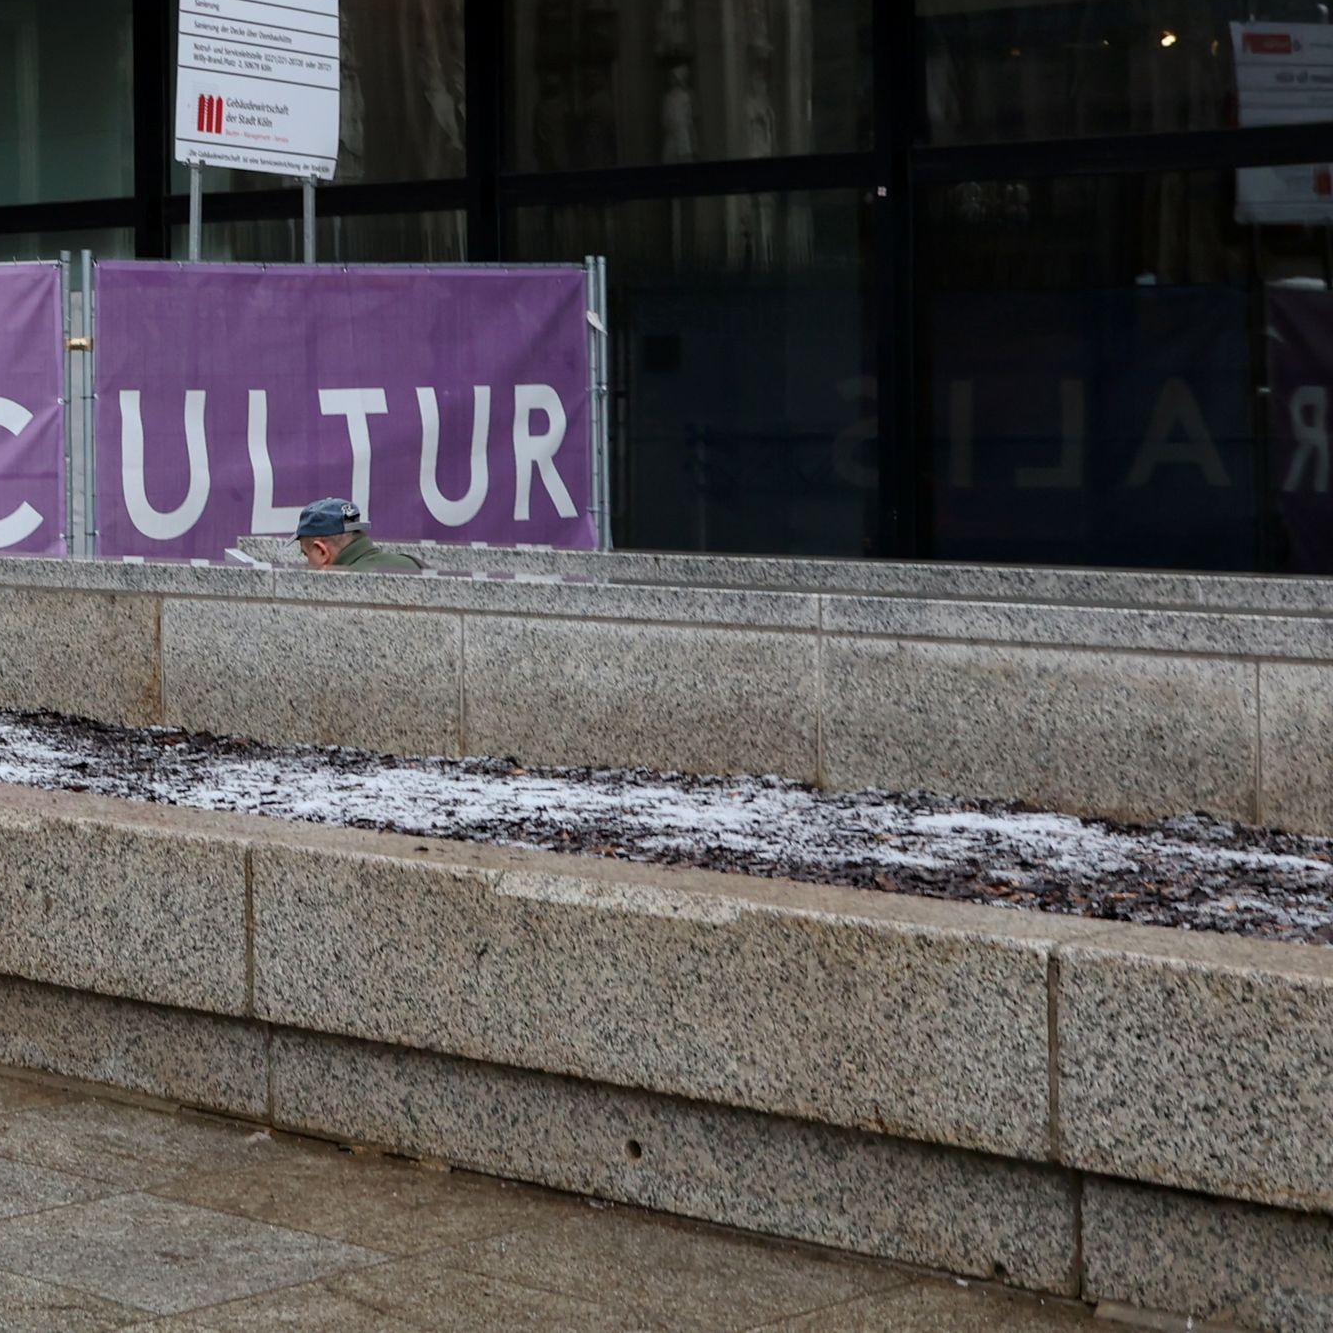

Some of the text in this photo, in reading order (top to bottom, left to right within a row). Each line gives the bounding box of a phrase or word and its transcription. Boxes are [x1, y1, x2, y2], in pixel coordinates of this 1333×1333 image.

[226, 97, 290, 116] Gebäudewirtschaft
[226, 114, 273, 128] der Stadt Köln
